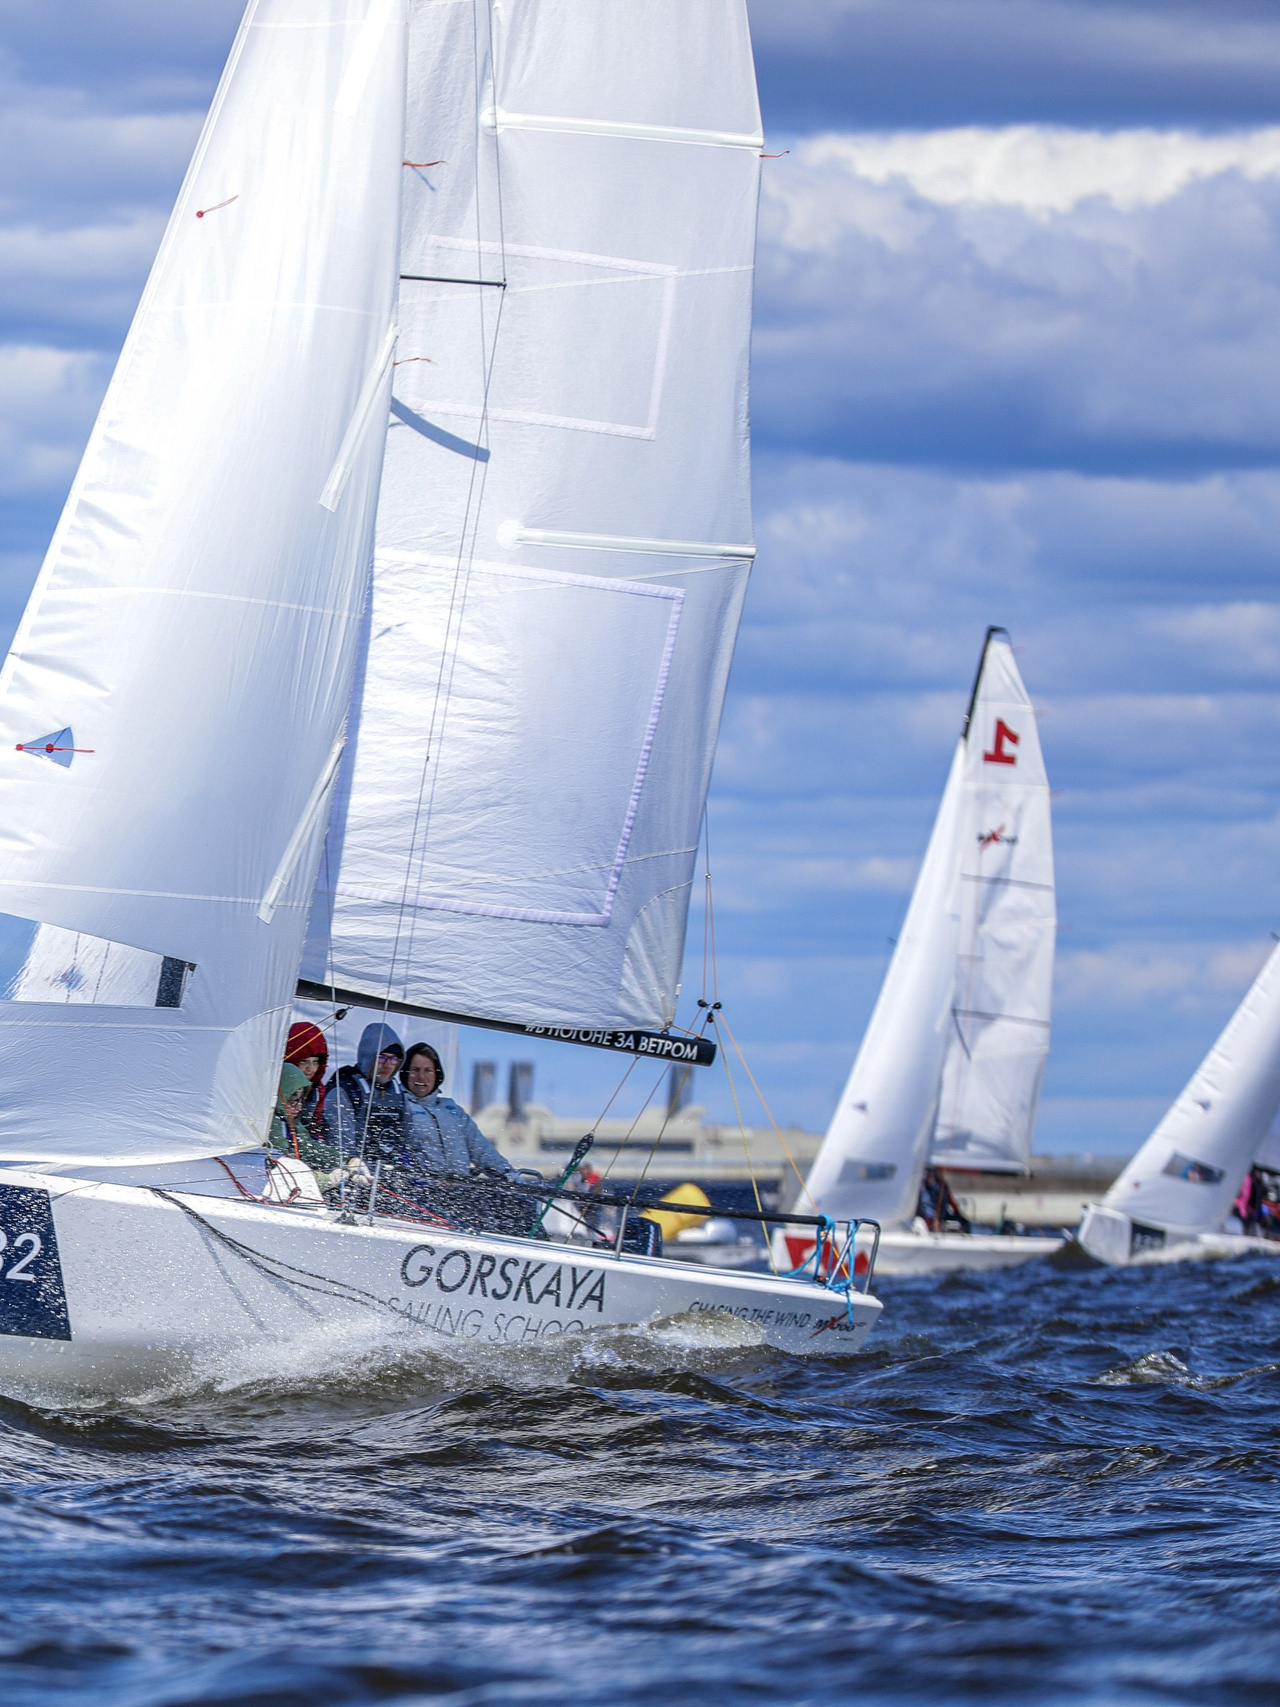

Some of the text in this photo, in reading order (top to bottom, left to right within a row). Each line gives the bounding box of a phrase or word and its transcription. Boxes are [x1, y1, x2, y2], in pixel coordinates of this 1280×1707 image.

[614, 1032, 635, 1050] ЗА
[638, 1037, 699, 1061] ВЕТРОМ
[400, 1244, 606, 1313] GORSKAYA
[750, 1308, 774, 1325] THE
[775, 1311, 812, 1328] WIND
